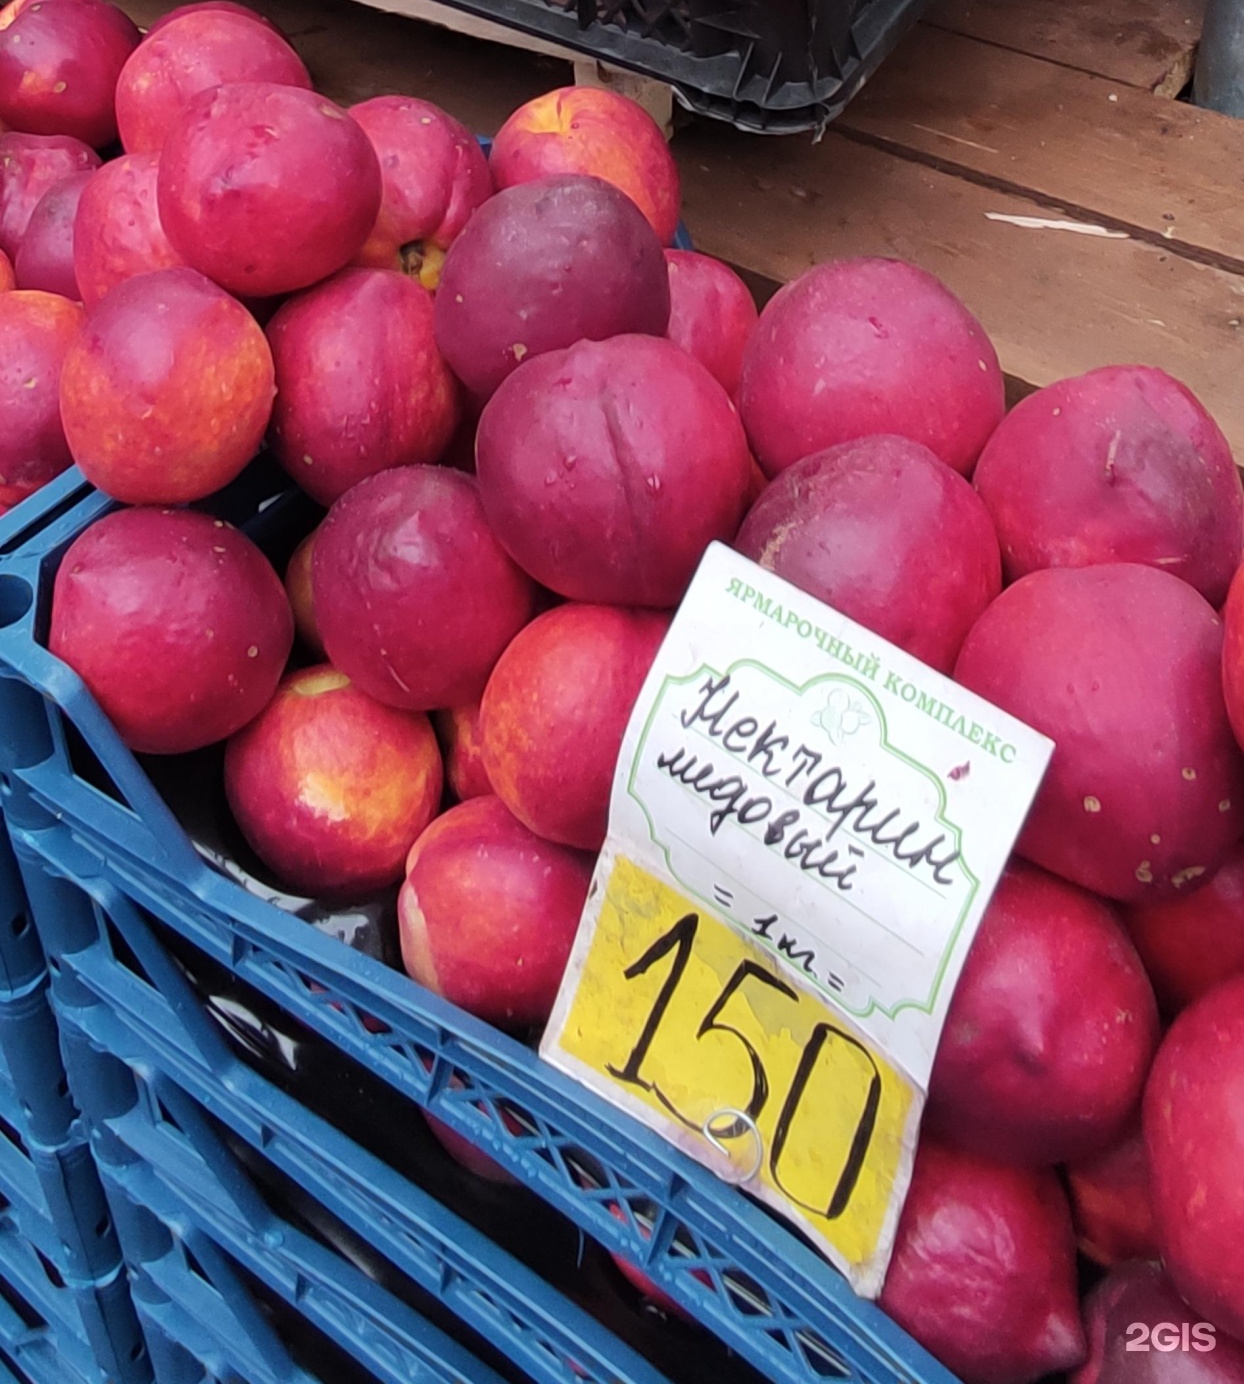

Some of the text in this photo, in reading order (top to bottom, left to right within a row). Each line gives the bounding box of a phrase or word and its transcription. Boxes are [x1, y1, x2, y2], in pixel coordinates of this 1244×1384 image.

[725, 577, 1017, 764] ЯРМАРОЧНЫЙ КОМПЛЕКС
[657, 747, 864, 890] медовый
[681, 675, 961, 885] Нектарин
[751, 914, 778, 941] 1
[605, 913, 882, 1221] 150
